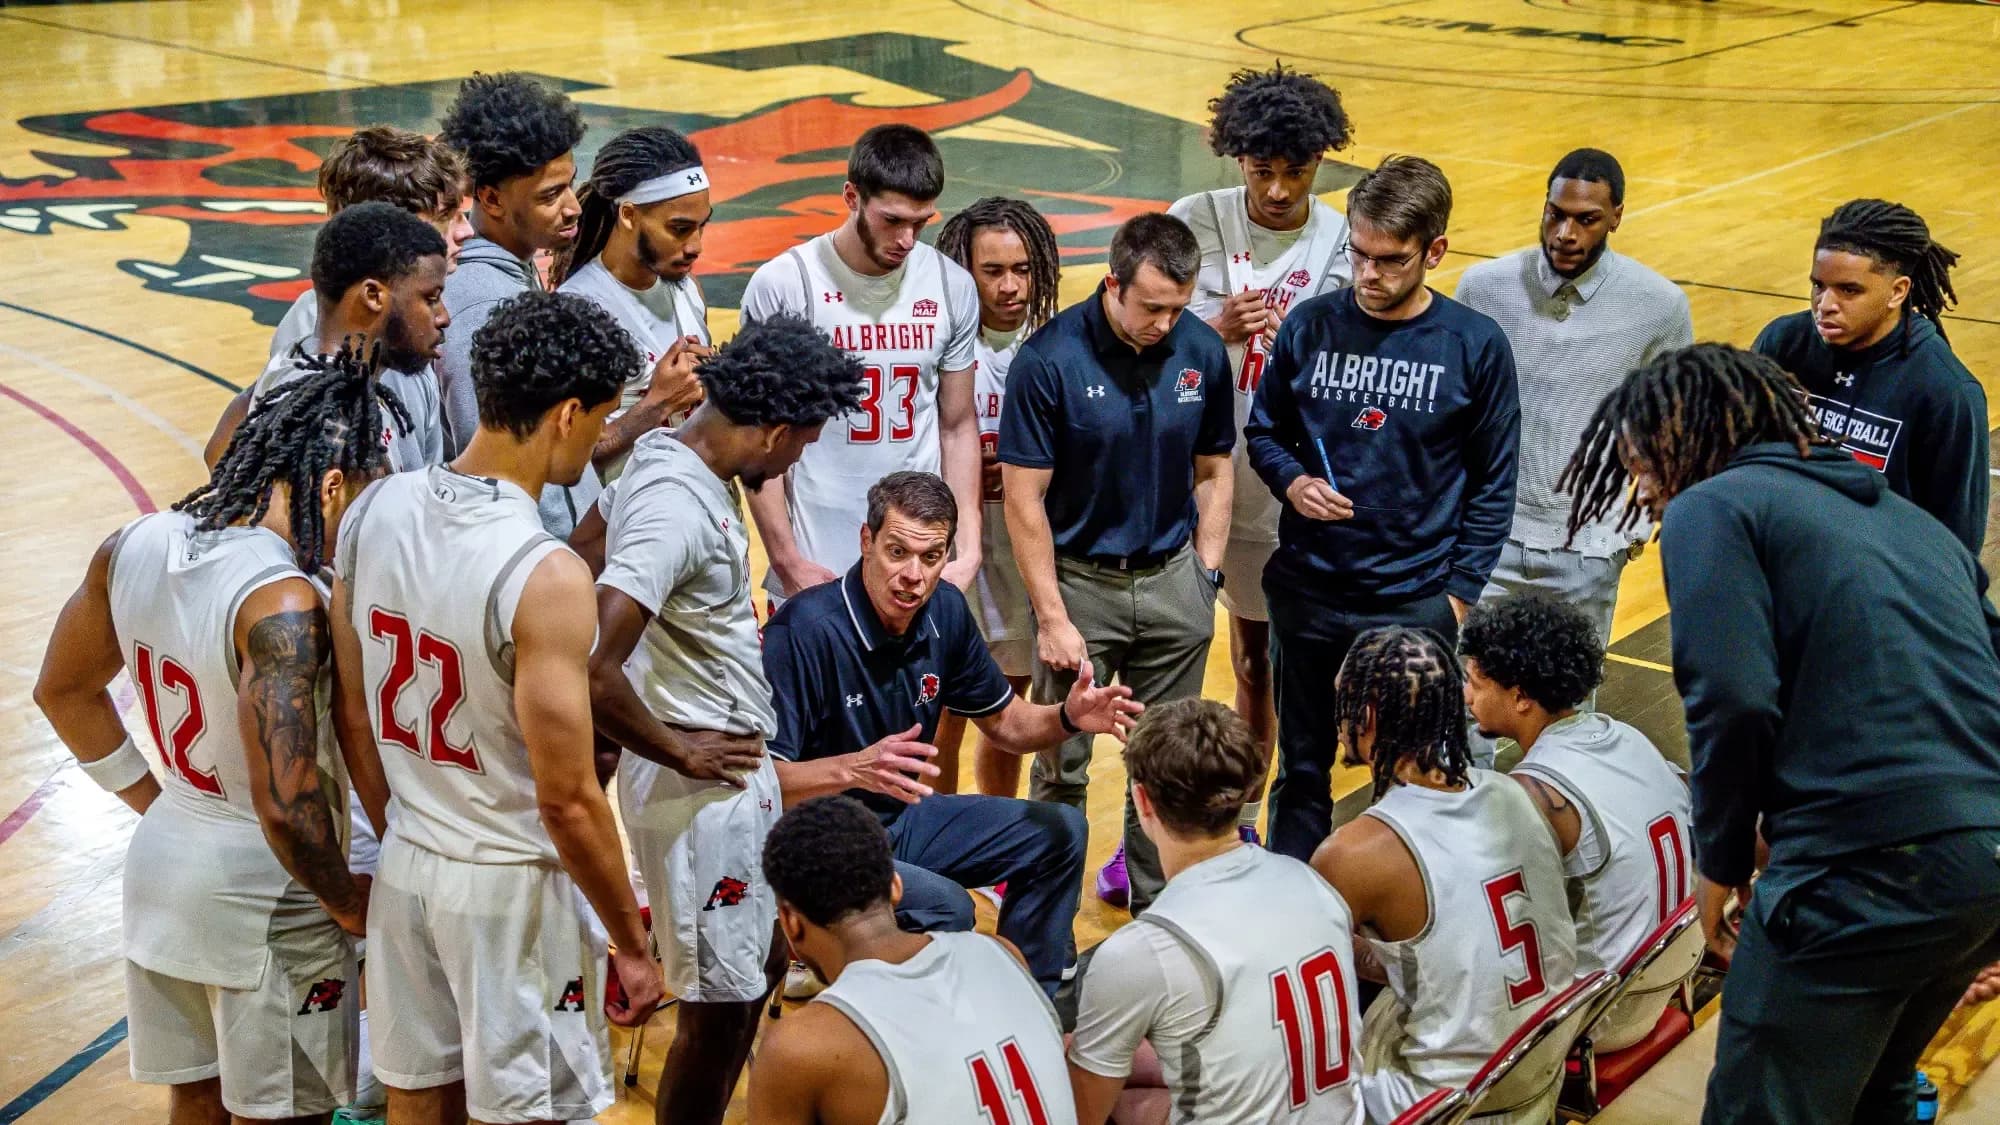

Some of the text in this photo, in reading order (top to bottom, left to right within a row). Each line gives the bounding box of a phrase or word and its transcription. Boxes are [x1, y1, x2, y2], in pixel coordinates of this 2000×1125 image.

[834, 323, 935, 351] ALBRIGHT
[1311, 351, 1445, 400] ALBRIGHT
[847, 363, 921, 445] 33
[1311, 386, 1434, 413] BASKETBALL
[133, 640, 227, 800] 12
[369, 604, 486, 776] 22
[1647, 811, 1687, 927] 0
[1481, 865, 1549, 1011] 5
[965, 1035, 1052, 1125] 11
[1269, 945, 1352, 1112] 10
